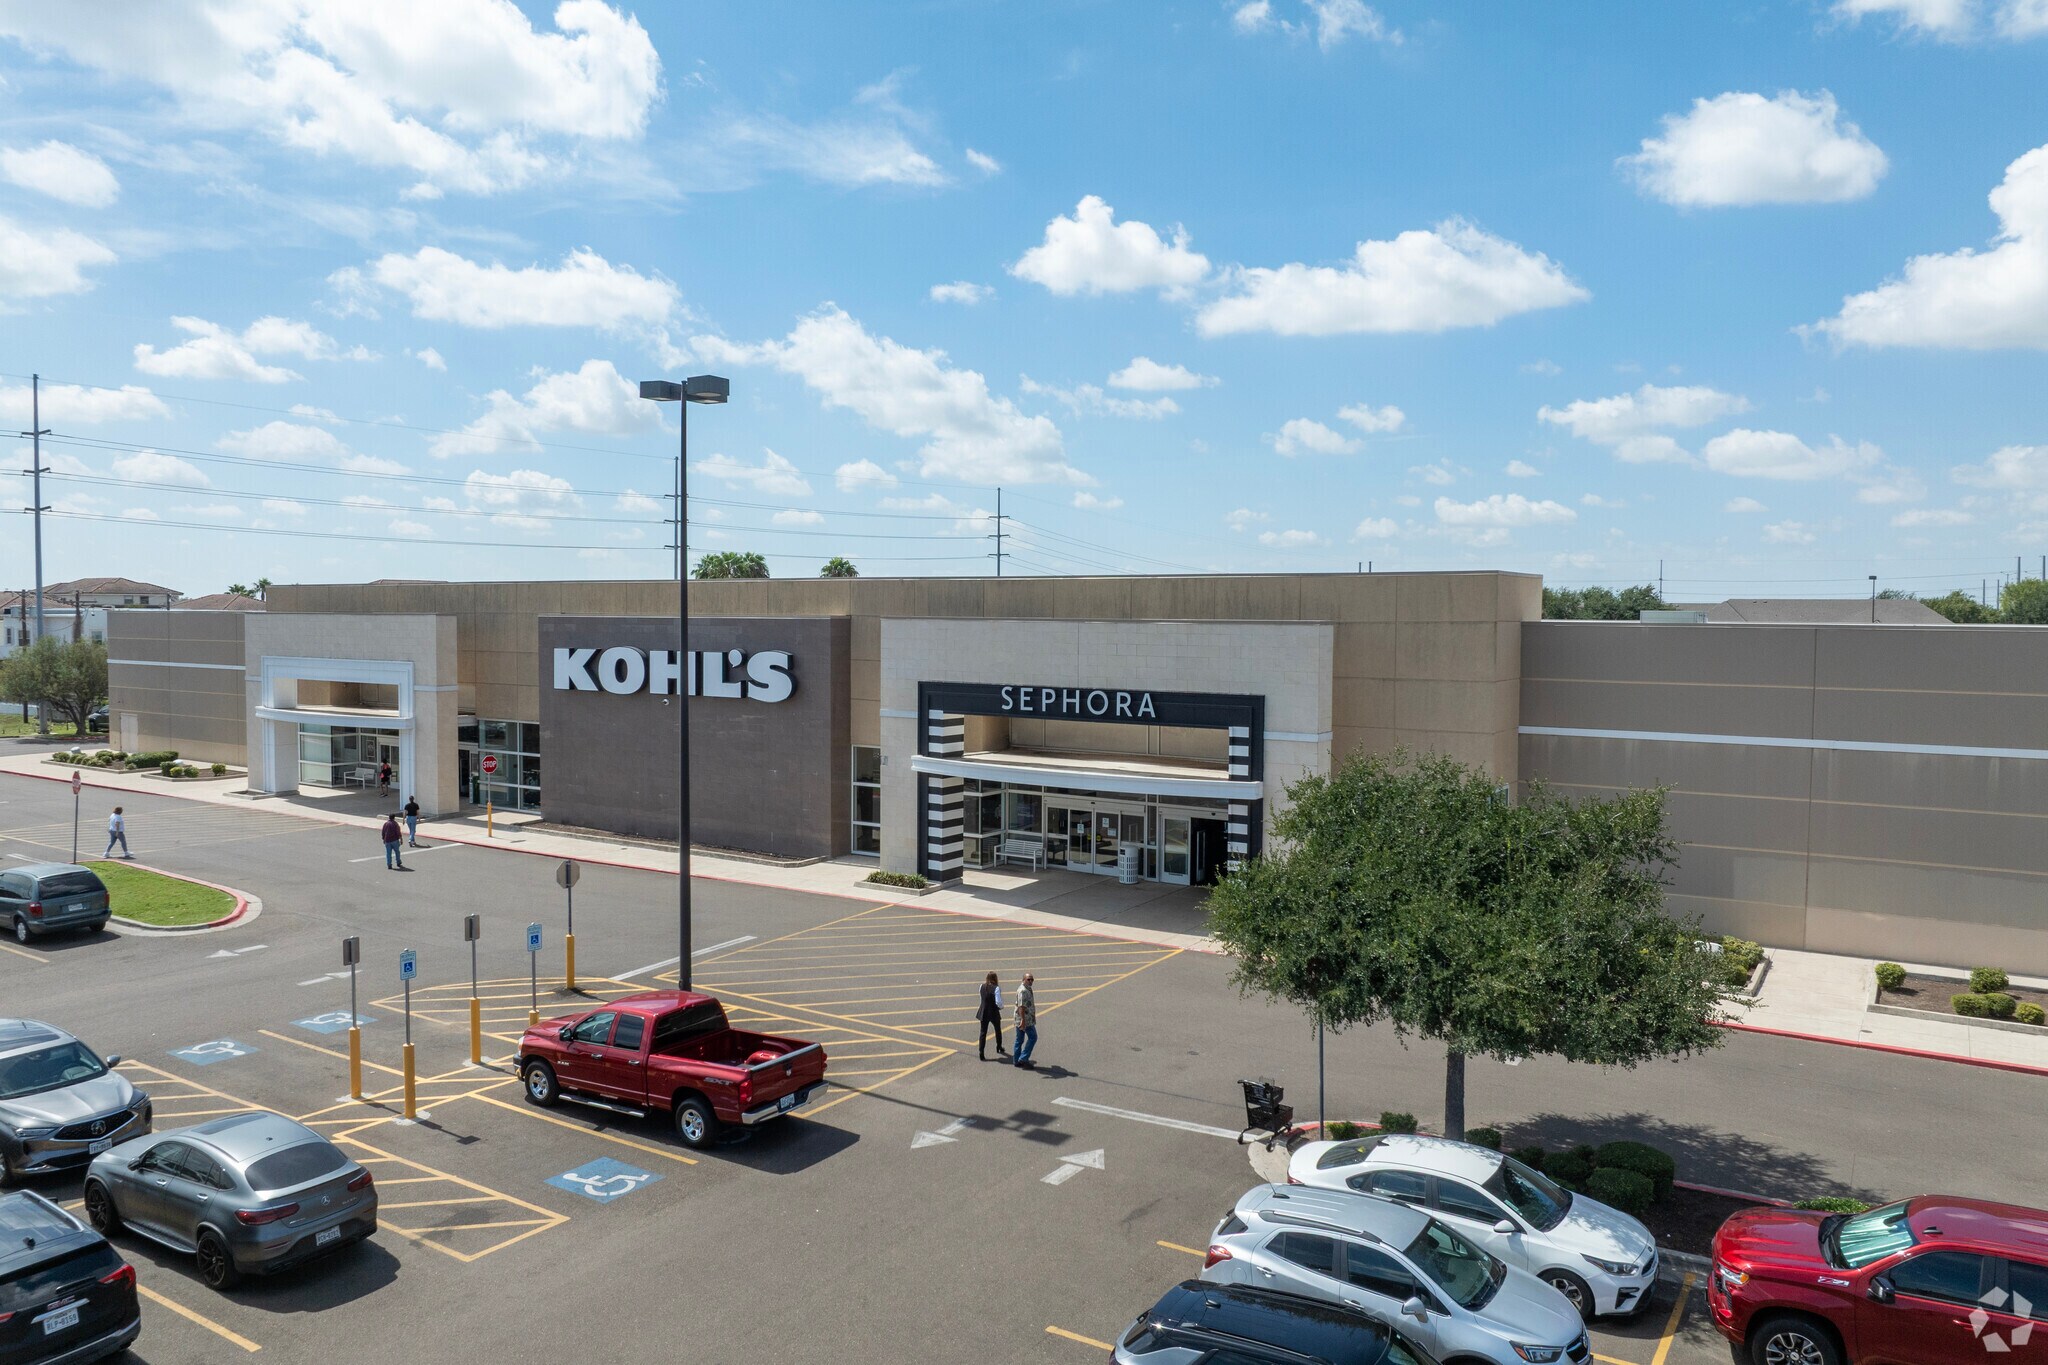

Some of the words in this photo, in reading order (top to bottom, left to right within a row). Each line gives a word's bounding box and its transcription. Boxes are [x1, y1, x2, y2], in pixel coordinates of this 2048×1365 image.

[553, 645, 794, 703] KOHL'S
[1001, 686, 1156, 718] SEPHORA
[483, 760, 496, 768] STOP
